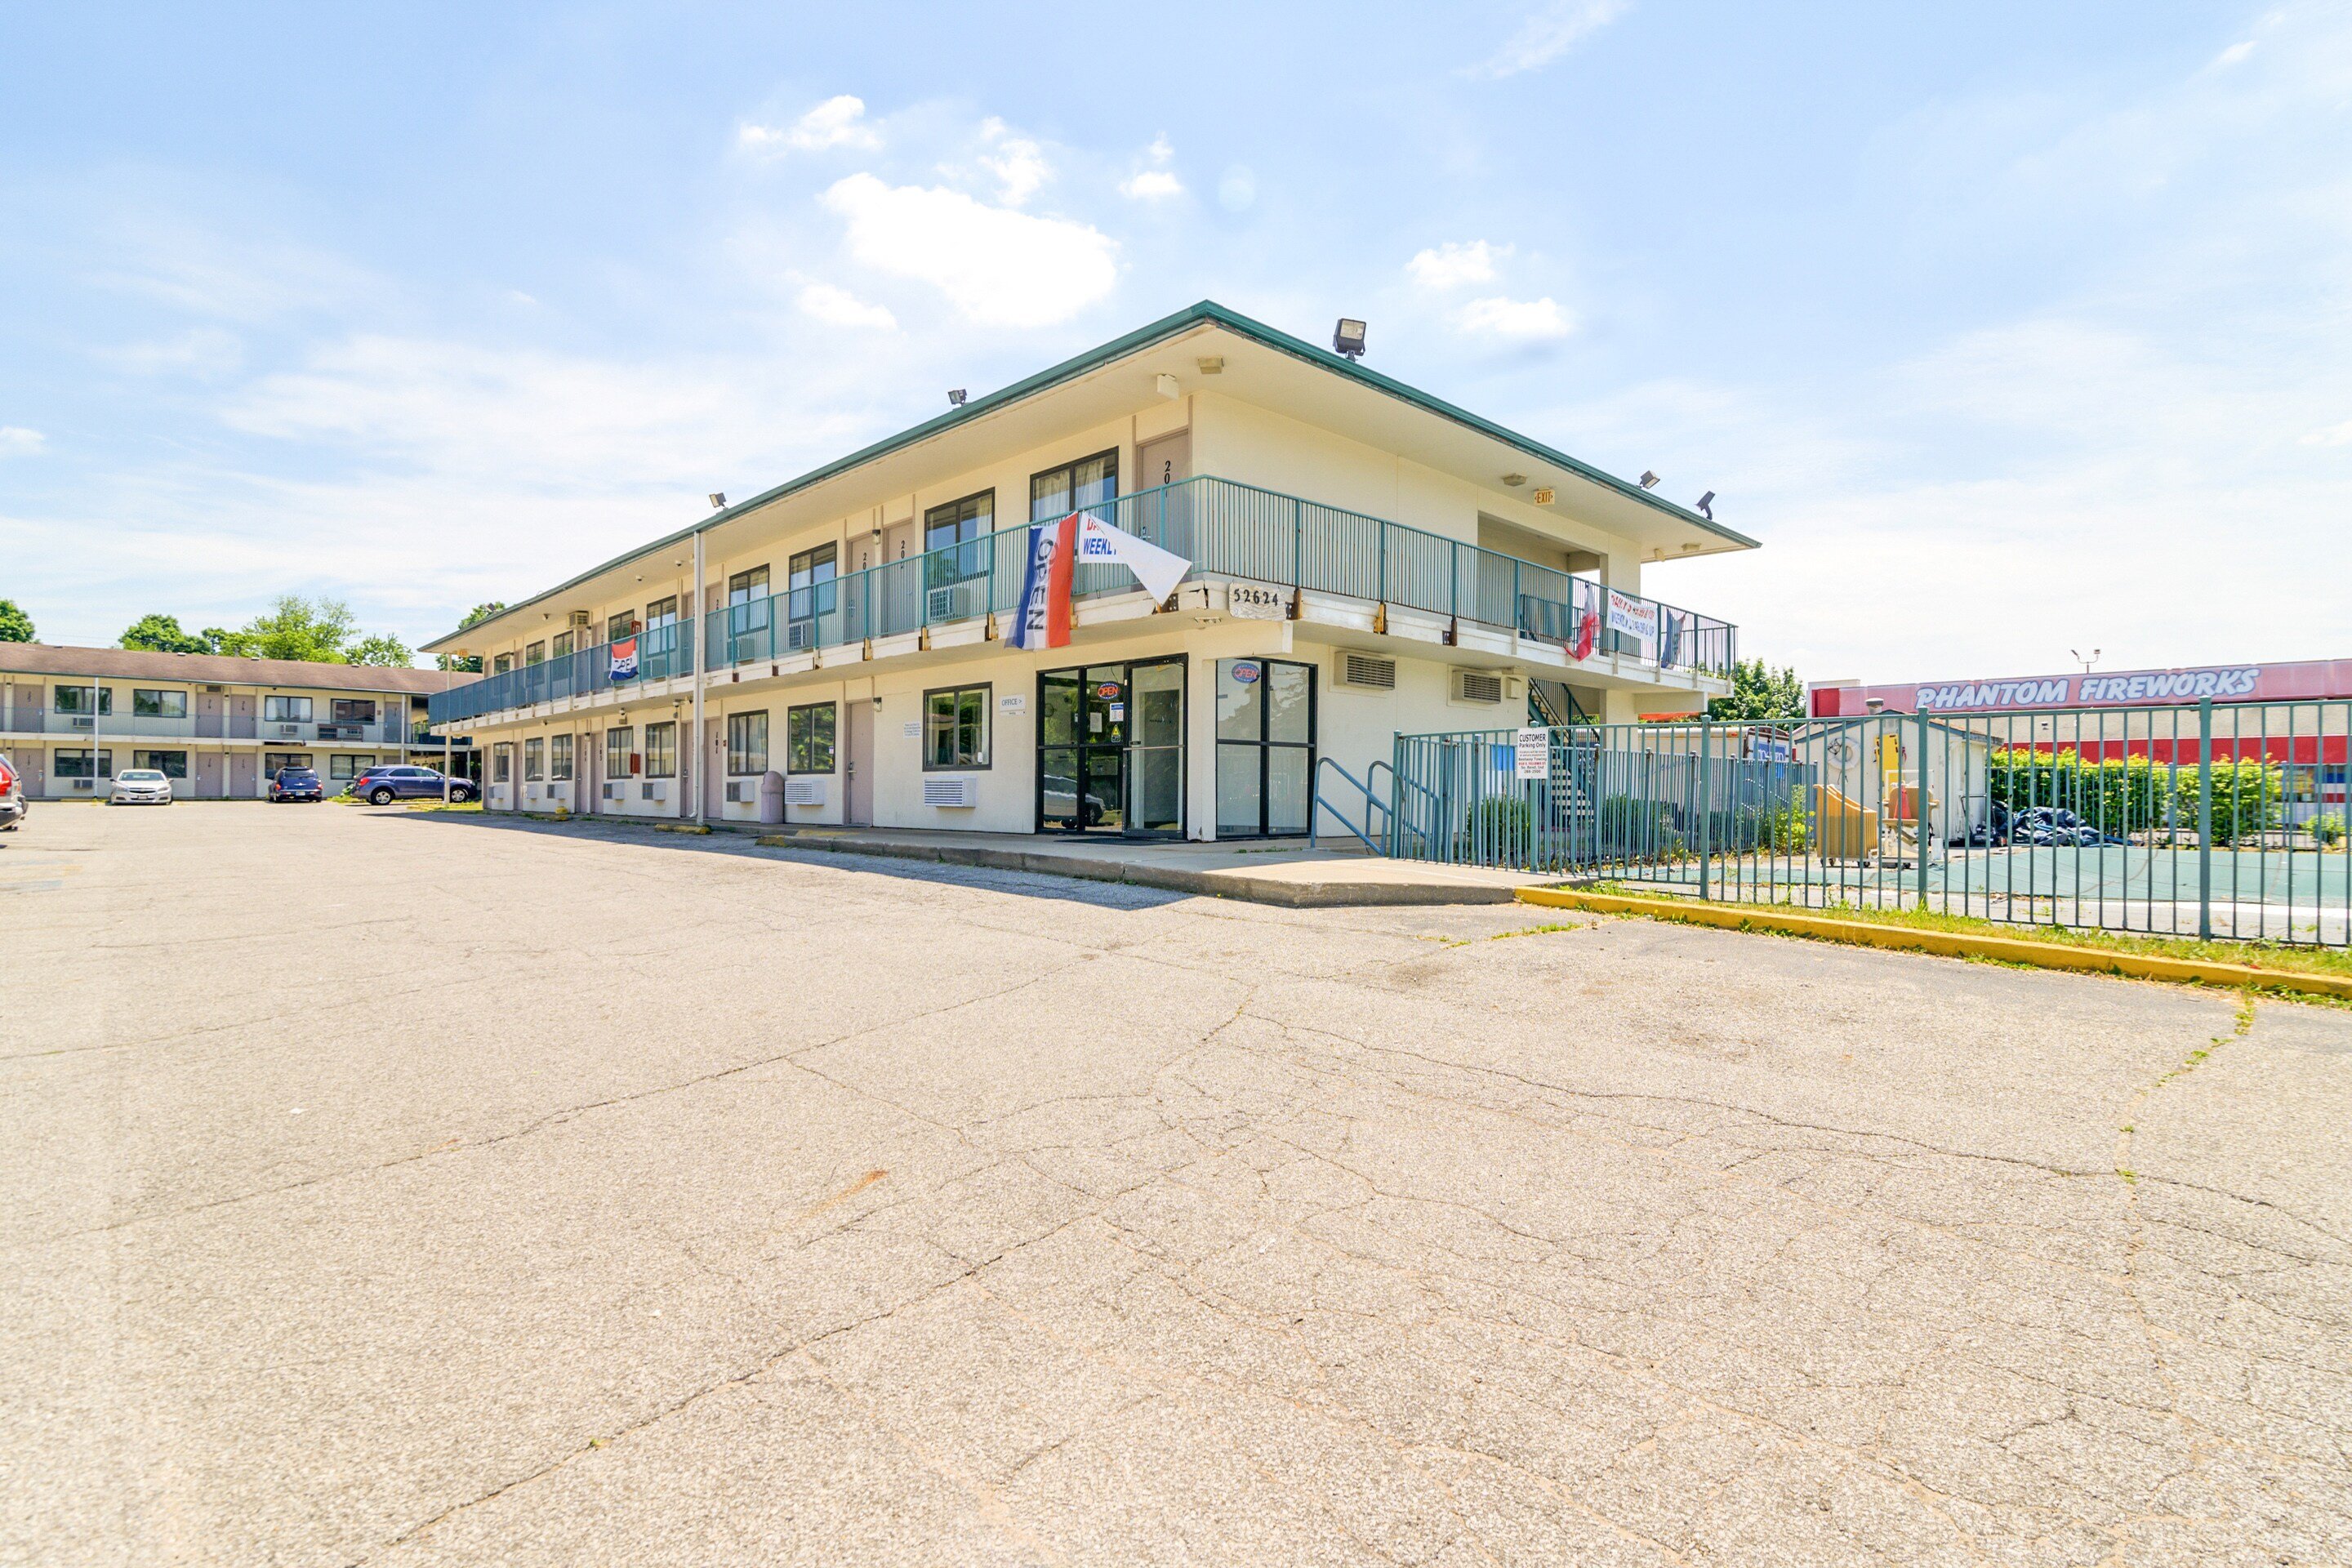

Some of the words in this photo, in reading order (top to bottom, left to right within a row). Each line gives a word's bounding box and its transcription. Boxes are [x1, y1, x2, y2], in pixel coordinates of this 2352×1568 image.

[1537, 491, 1552, 504] EXIT
[1027, 538, 1054, 630] OPEN
[1233, 588, 1279, 607] 52624
[1234, 667, 1258, 679] OPEN
[1098, 686, 1119, 697] OPEN
[1915, 679, 2070, 710] PHANTOM
[2078, 668, 2262, 702] FIREWORKS
[1001, 698, 1018, 706] OFFICE
[1519, 733, 1547, 742] CUSTOMER
